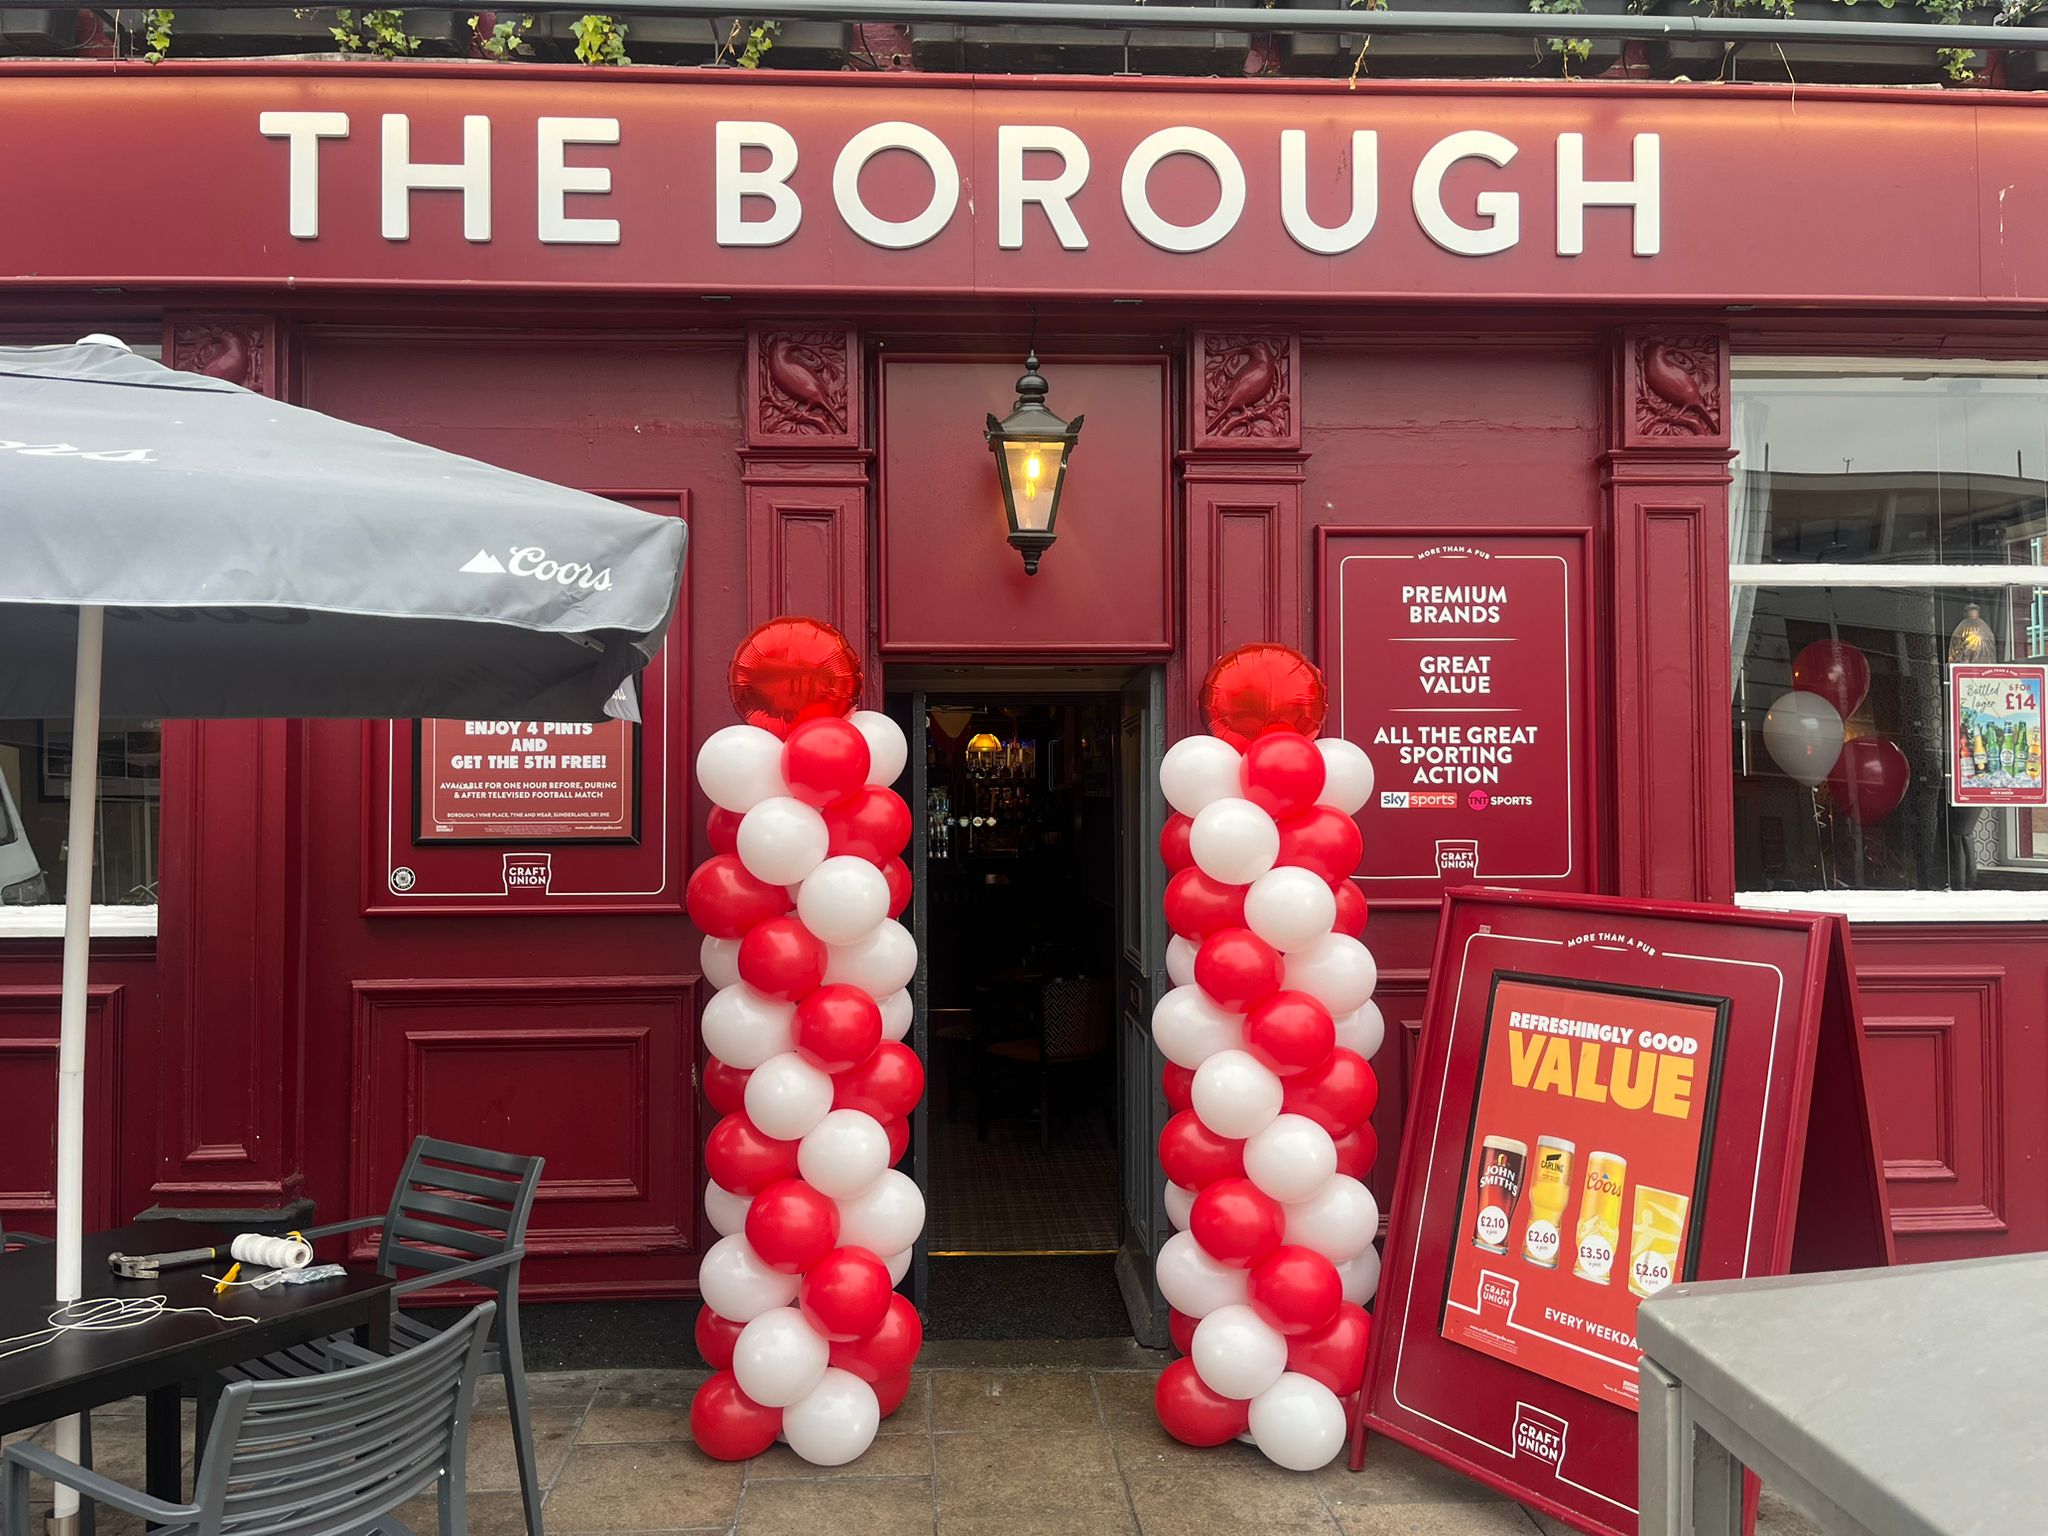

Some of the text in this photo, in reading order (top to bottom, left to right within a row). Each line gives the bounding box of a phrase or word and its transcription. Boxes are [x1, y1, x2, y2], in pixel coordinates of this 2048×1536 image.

[258, 110, 1662, 259] THE BOROUGH
[1417, 547, 1441, 560] MORE
[1474, 549, 1491, 560] PUB
[509, 546, 613, 592] Coors
[1402, 585, 1507, 603] PREMIUM
[1409, 605, 1500, 623] BRANDS
[1419, 656, 1491, 674] GREAT
[1419, 676, 1491, 694] VALUE
[1967, 683, 2001, 696] Bottled
[2006, 692, 2036, 710] £14
[465, 721, 593, 735] ENJOY 4 PINTS
[1373, 726, 1538, 744] ALL THE GREAT
[510, 738, 548, 752] AND
[451, 755, 607, 769] GET THE 5TH FREE!
[1400, 746, 1512, 764] SPORTING
[1413, 766, 1498, 784] ACTION
[440, 782, 617, 791] AVAILABLE FOR ONE HOUR BEFORE, DURING
[454, 791, 603, 799] & AFTER TELEVISED FOOTBALL MATCH
[1383, 792, 1455, 807] sky sports
[1468, 796, 1532, 805] TNT SPORTS
[1441, 852, 1473, 861] CRAFT
[1441, 860, 1474, 869] UNION
[509, 867, 546, 876] CRAFT
[509, 876, 546, 885] UNION
[1567, 932, 1657, 957] MORE THAN A PUB
[1509, 1011, 1698, 1055] REFRESHINGLY GOOD
[1508, 1030, 1694, 1120] VALUE
[1484, 1164, 1516, 1182] JOHN
[1540, 1160, 1564, 1173] CARLING
[1479, 1175, 1518, 1197] SMITH'S
[1585, 1171, 1622, 1198] Coors
[1480, 1216, 1505, 1229] £2.10
[1528, 1230, 1557, 1244] £2.60
[1580, 1246, 1610, 1261] £3.50
[1636, 1263, 1668, 1278] £2.60
[1482, 1291, 1510, 1307] UNION
[1483, 1283, 1511, 1299] CRAFT
[1544, 1307, 1643, 1351] EVERY WEEKDA
[1519, 1423, 1560, 1448] CRAFT
[1517, 1434, 1558, 1462] UNION
